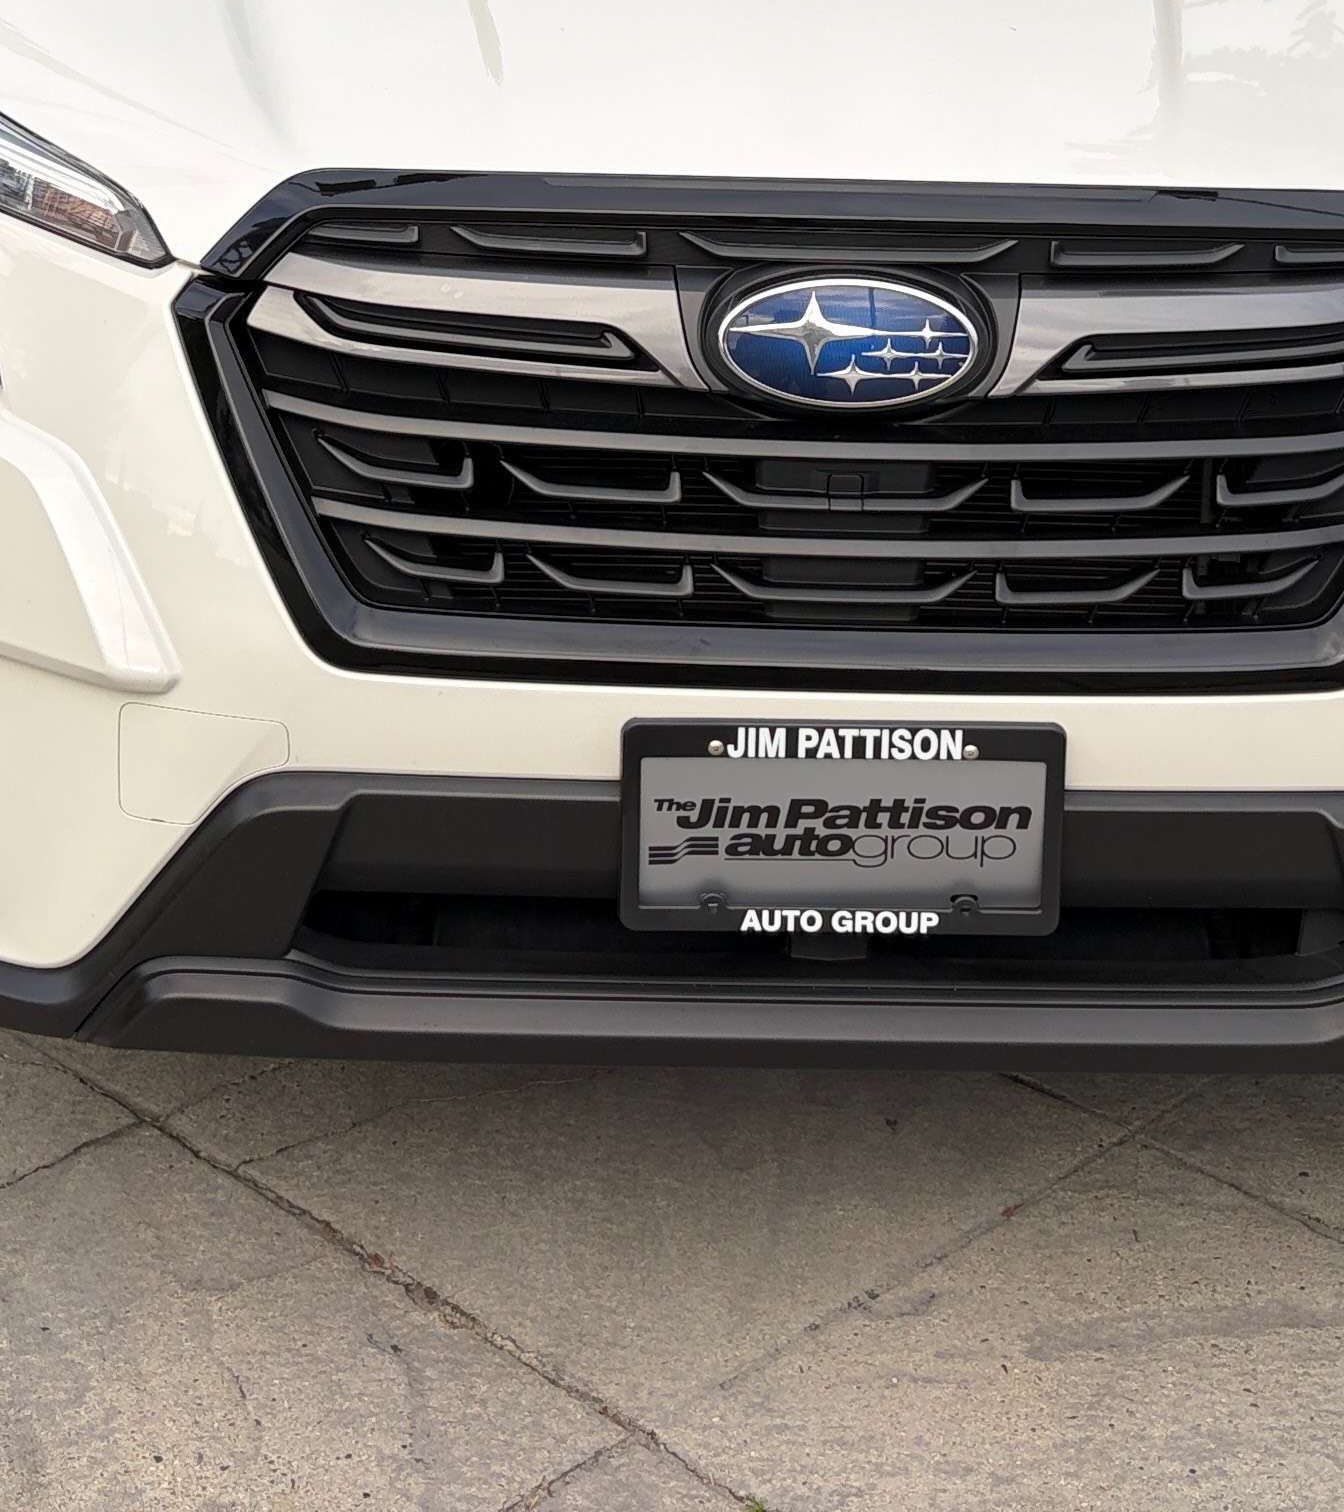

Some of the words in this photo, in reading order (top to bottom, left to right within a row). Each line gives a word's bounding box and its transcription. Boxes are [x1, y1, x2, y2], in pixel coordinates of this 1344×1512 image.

[726, 727, 787, 759] JIM
[797, 728, 964, 761] PATTISON
[654, 797, 696, 813] The
[676, 797, 783, 829] Jim
[783, 798, 1033, 831] Pattison
[740, 909, 824, 934] AUTO
[831, 910, 940, 935] GROUP
